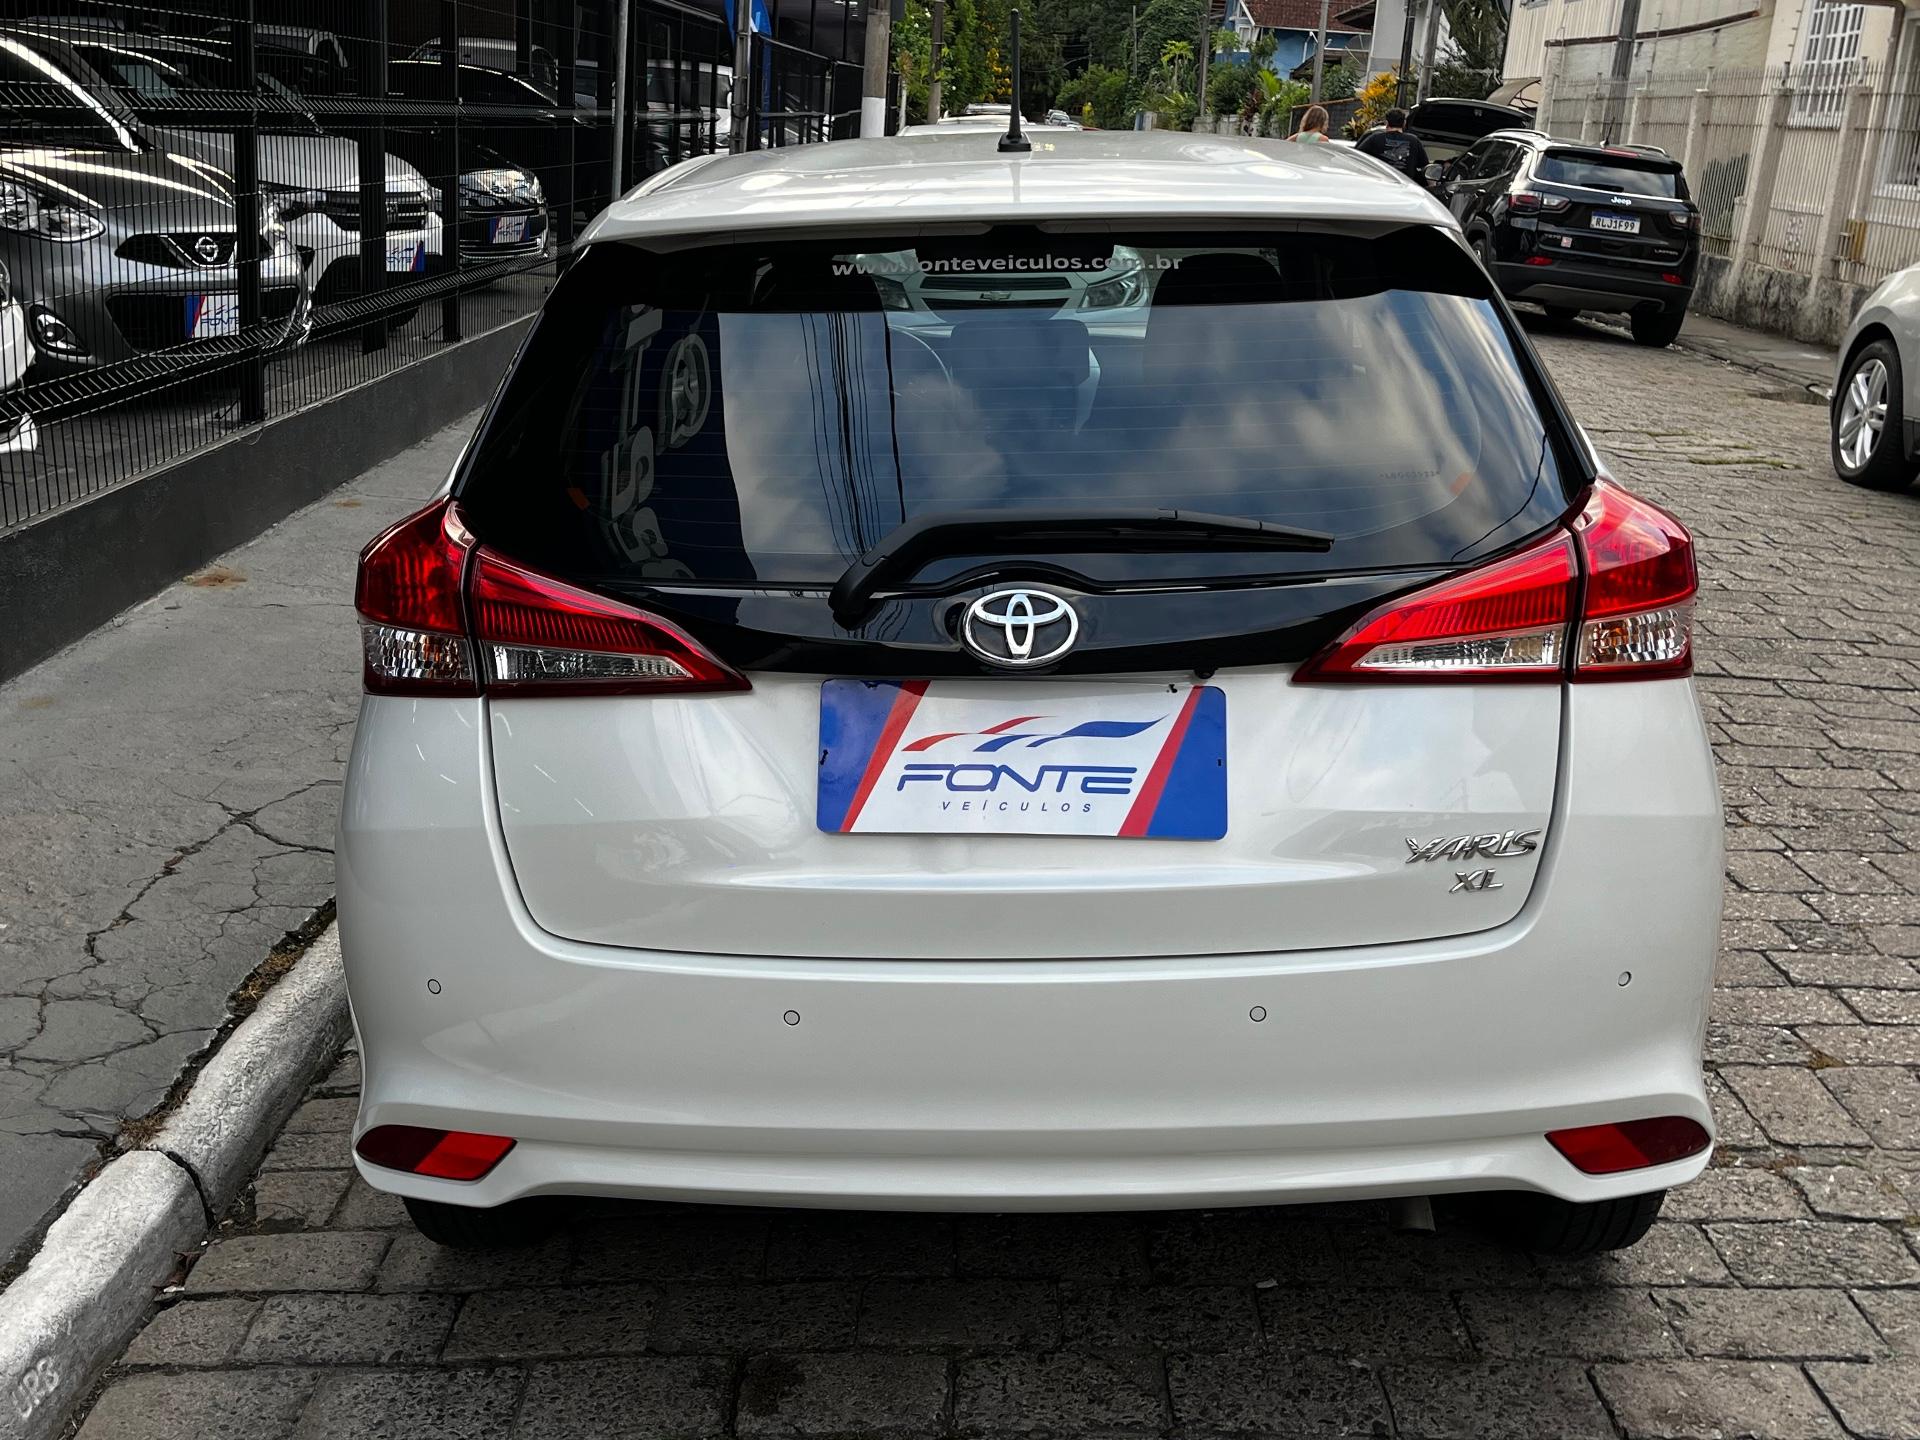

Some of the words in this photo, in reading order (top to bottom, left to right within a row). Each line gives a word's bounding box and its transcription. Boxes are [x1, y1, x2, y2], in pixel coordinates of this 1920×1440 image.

[1611, 196, 1632, 206] Jeep
[1595, 217, 1636, 231] RLJ1F99
[832, 254, 1183, 276] www.fonteveiculos.com.br
[896, 763, 1138, 794] FONTE
[941, 799, 1092, 813] VEÍCULOS
[1448, 867, 1505, 894] XL
